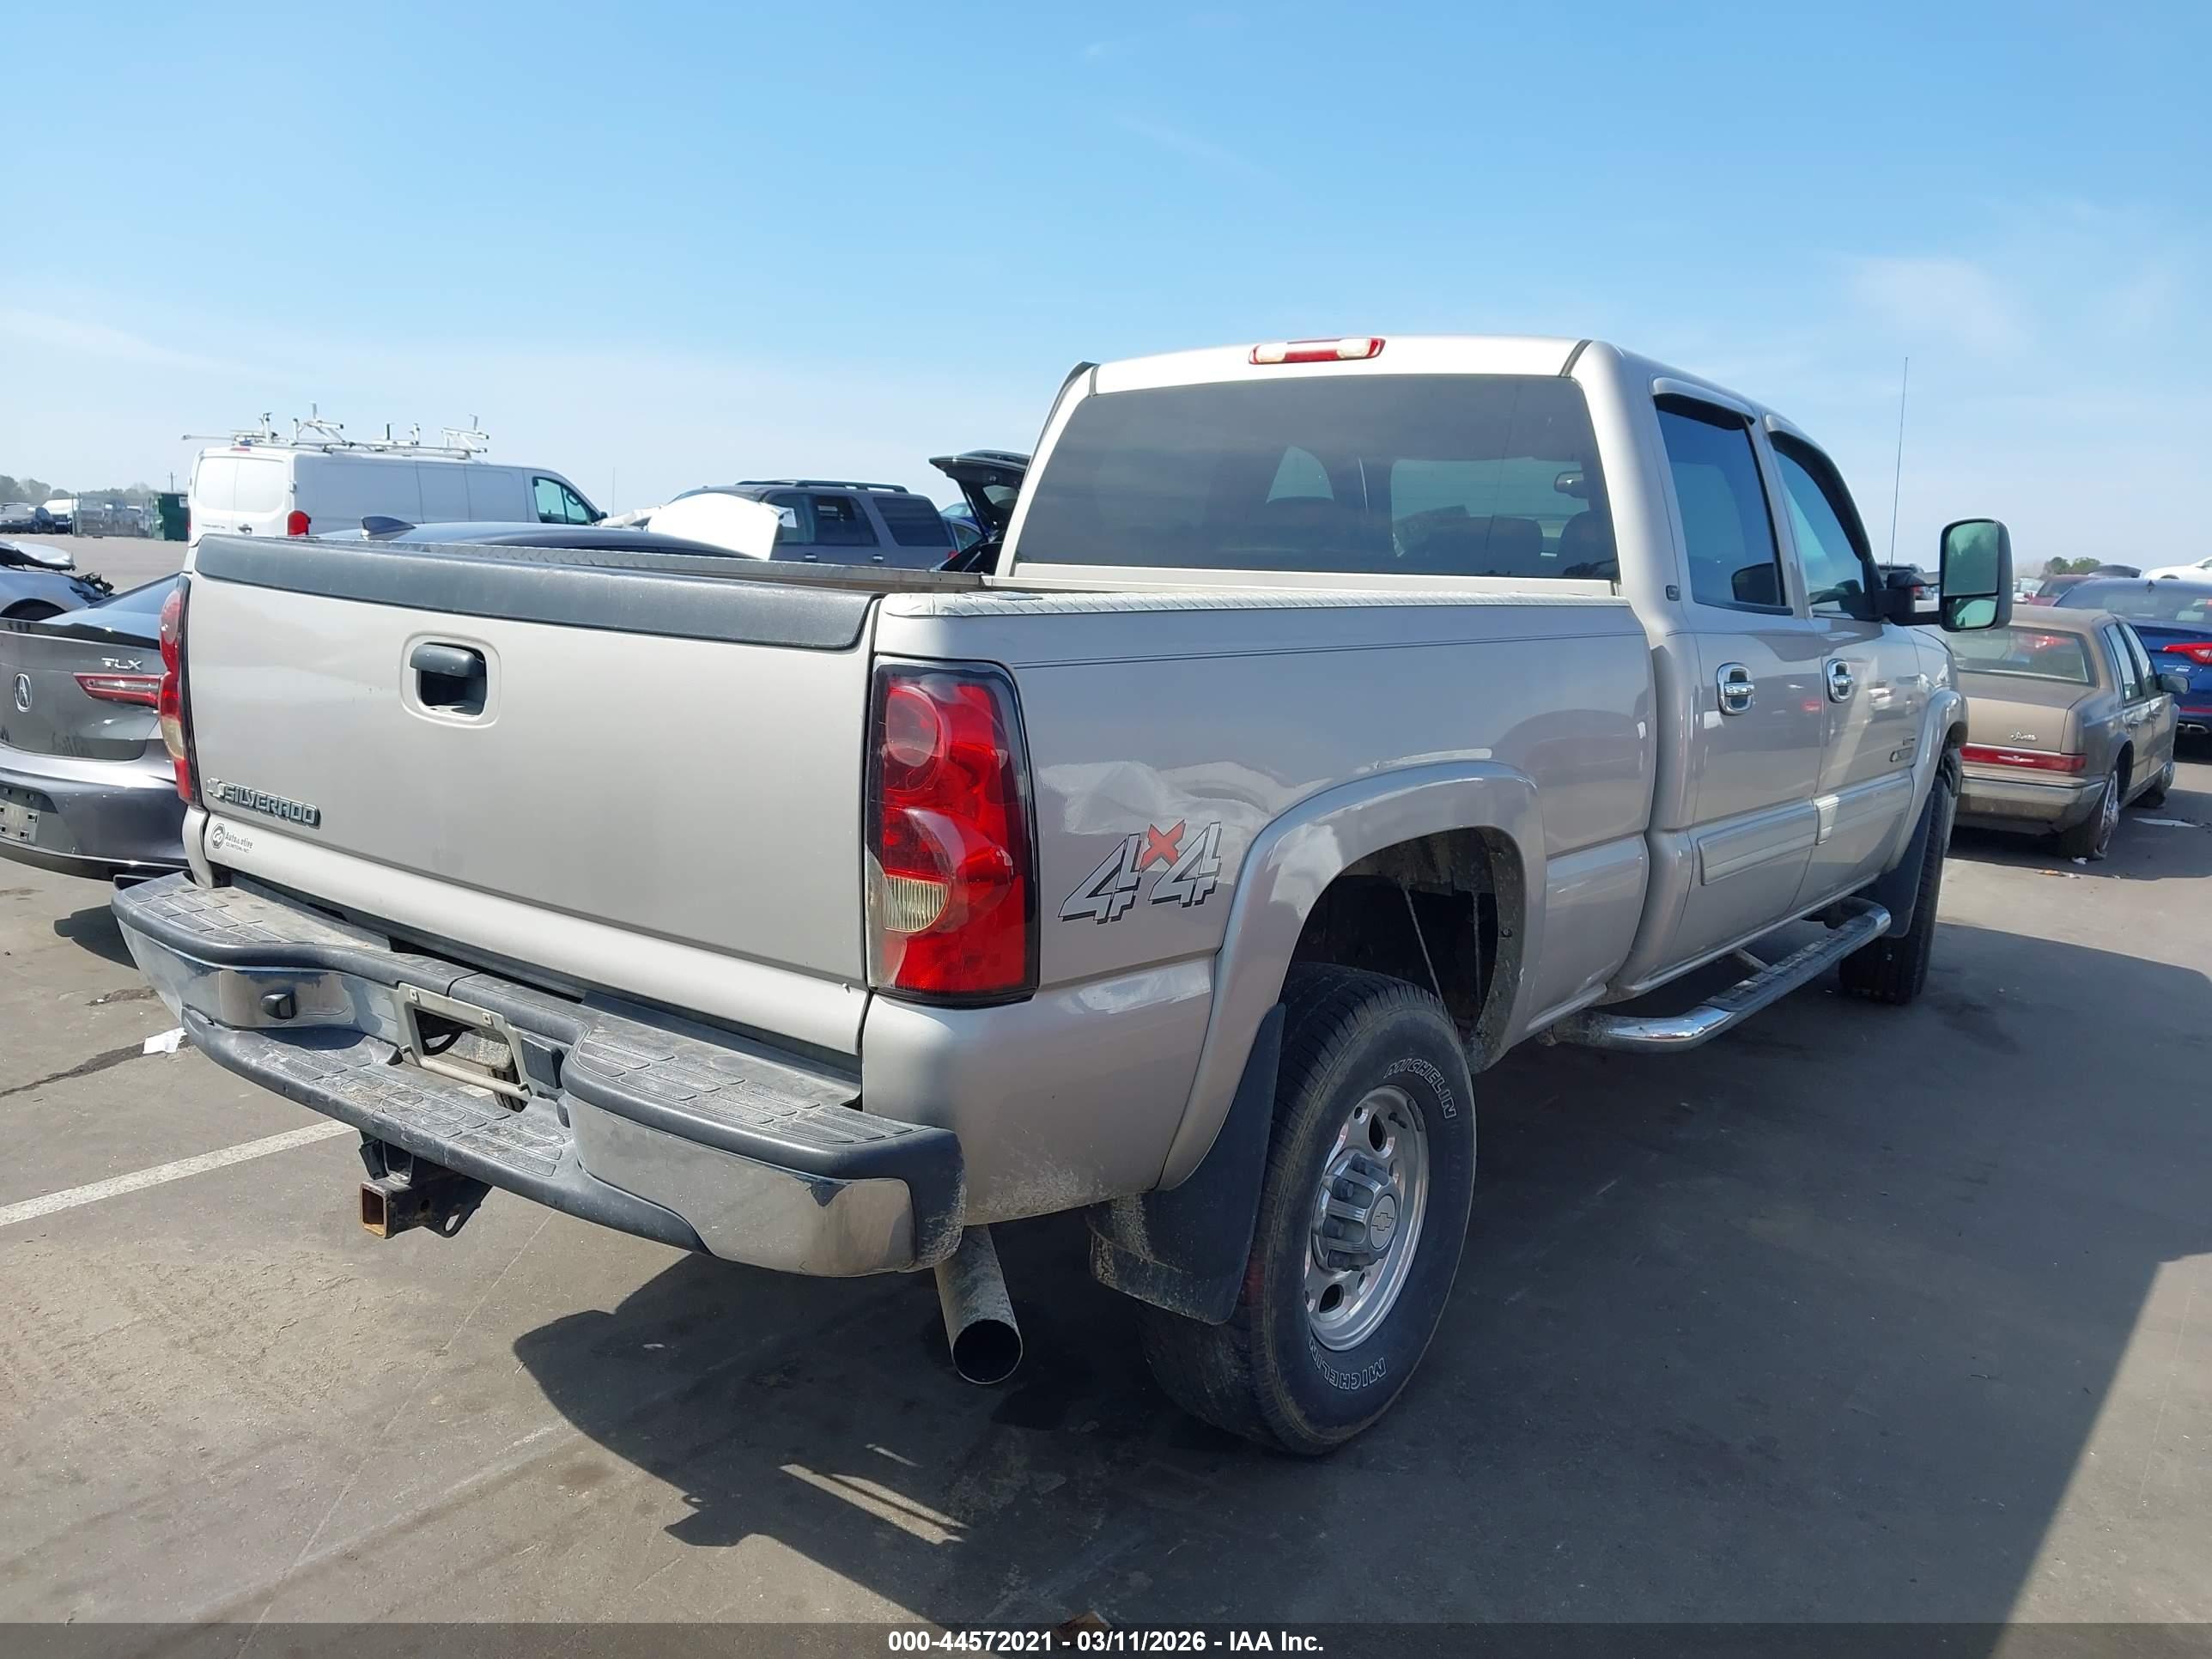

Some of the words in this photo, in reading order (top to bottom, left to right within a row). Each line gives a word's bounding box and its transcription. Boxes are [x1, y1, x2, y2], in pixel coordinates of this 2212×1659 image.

[101, 657, 143, 672] TLX
[224, 783, 318, 825] SILVERADO
[1382, 1058, 1457, 1119] MICHELIN
[1309, 1337, 1387, 1390] MICHELIN
